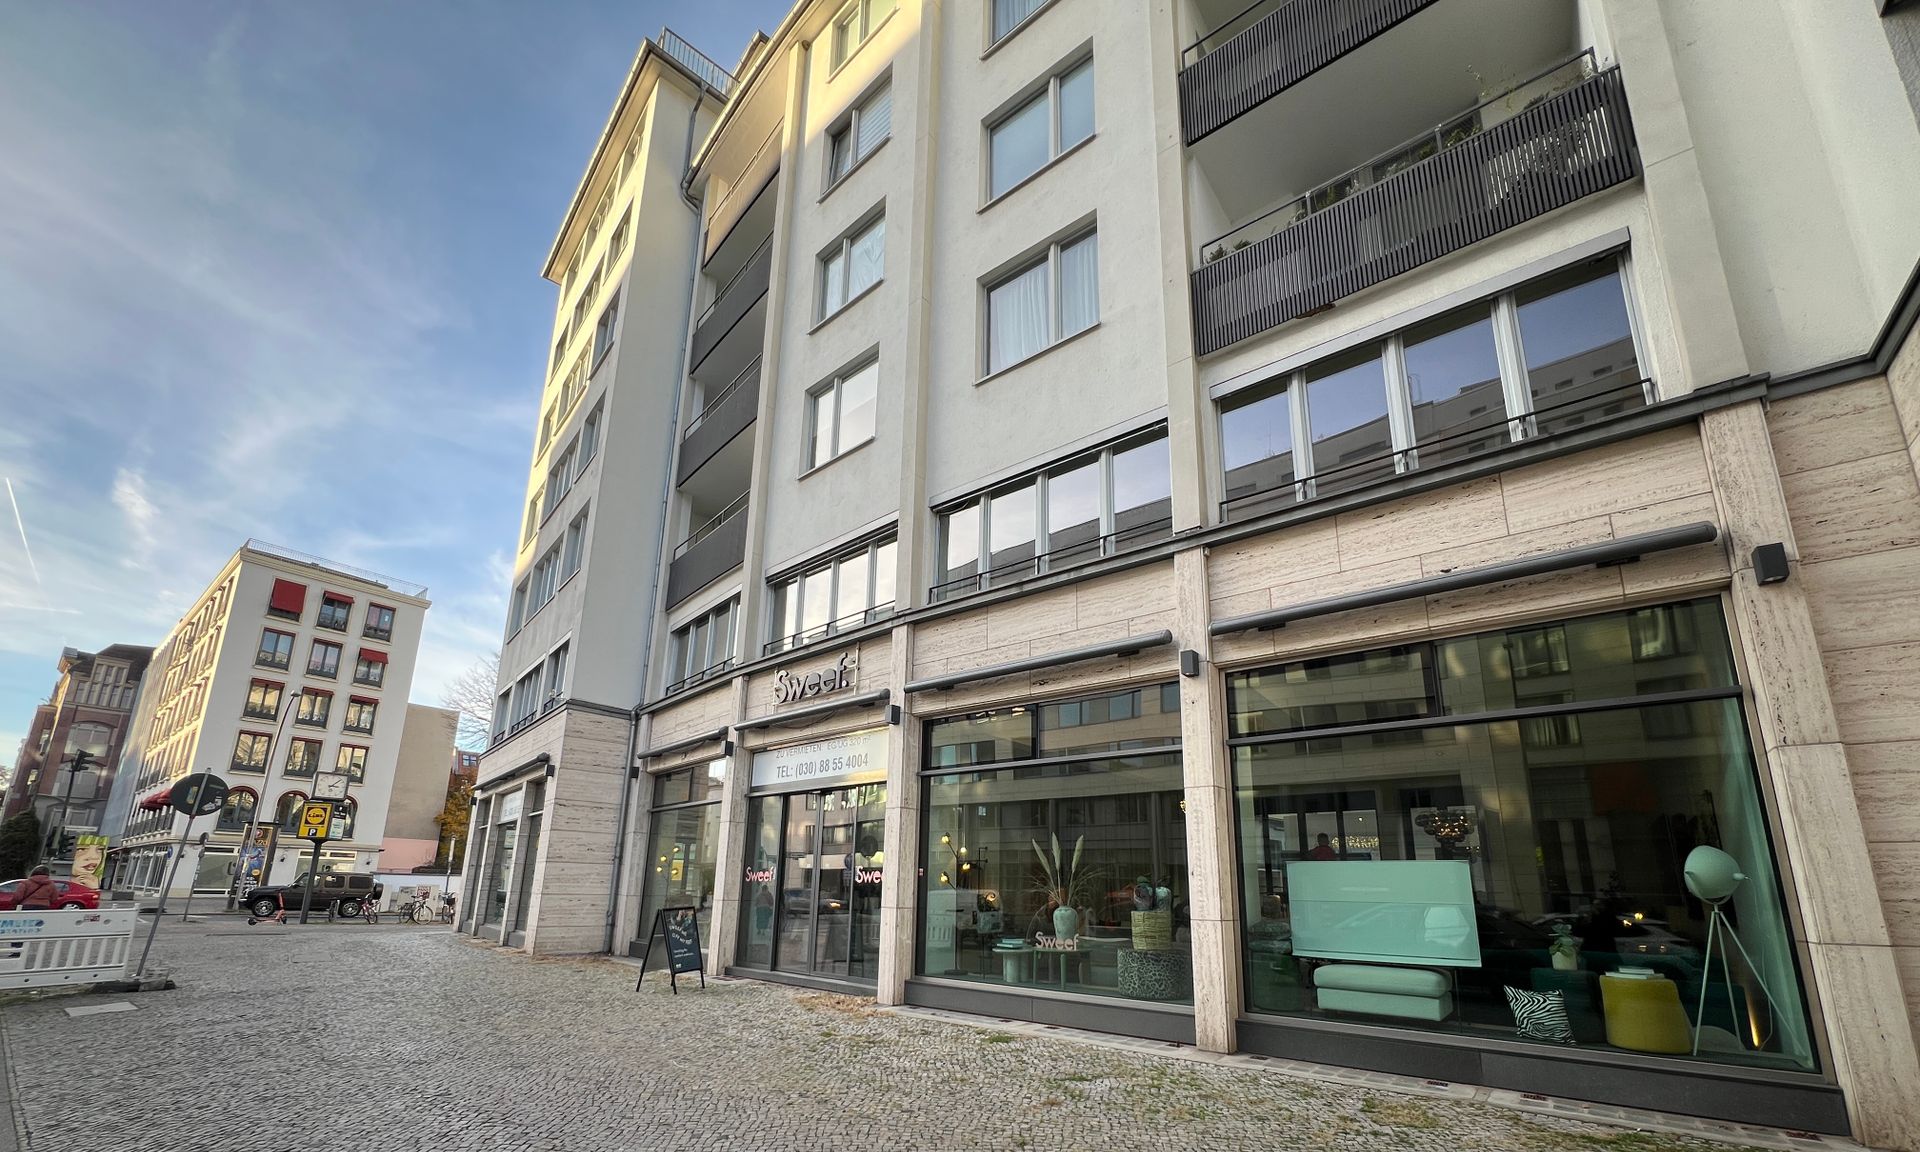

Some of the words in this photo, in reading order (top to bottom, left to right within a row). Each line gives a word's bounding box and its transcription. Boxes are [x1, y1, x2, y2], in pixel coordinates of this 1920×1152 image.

[776, 764, 793, 779] TEL:
[795, 761, 817, 779] (030)
[819, 758, 830, 773] 88
[832, 757, 843, 771] 55
[845, 753, 869, 769] 4004
[745, 866, 773, 882] Sweef
[1035, 931, 1079, 951] Sweef
